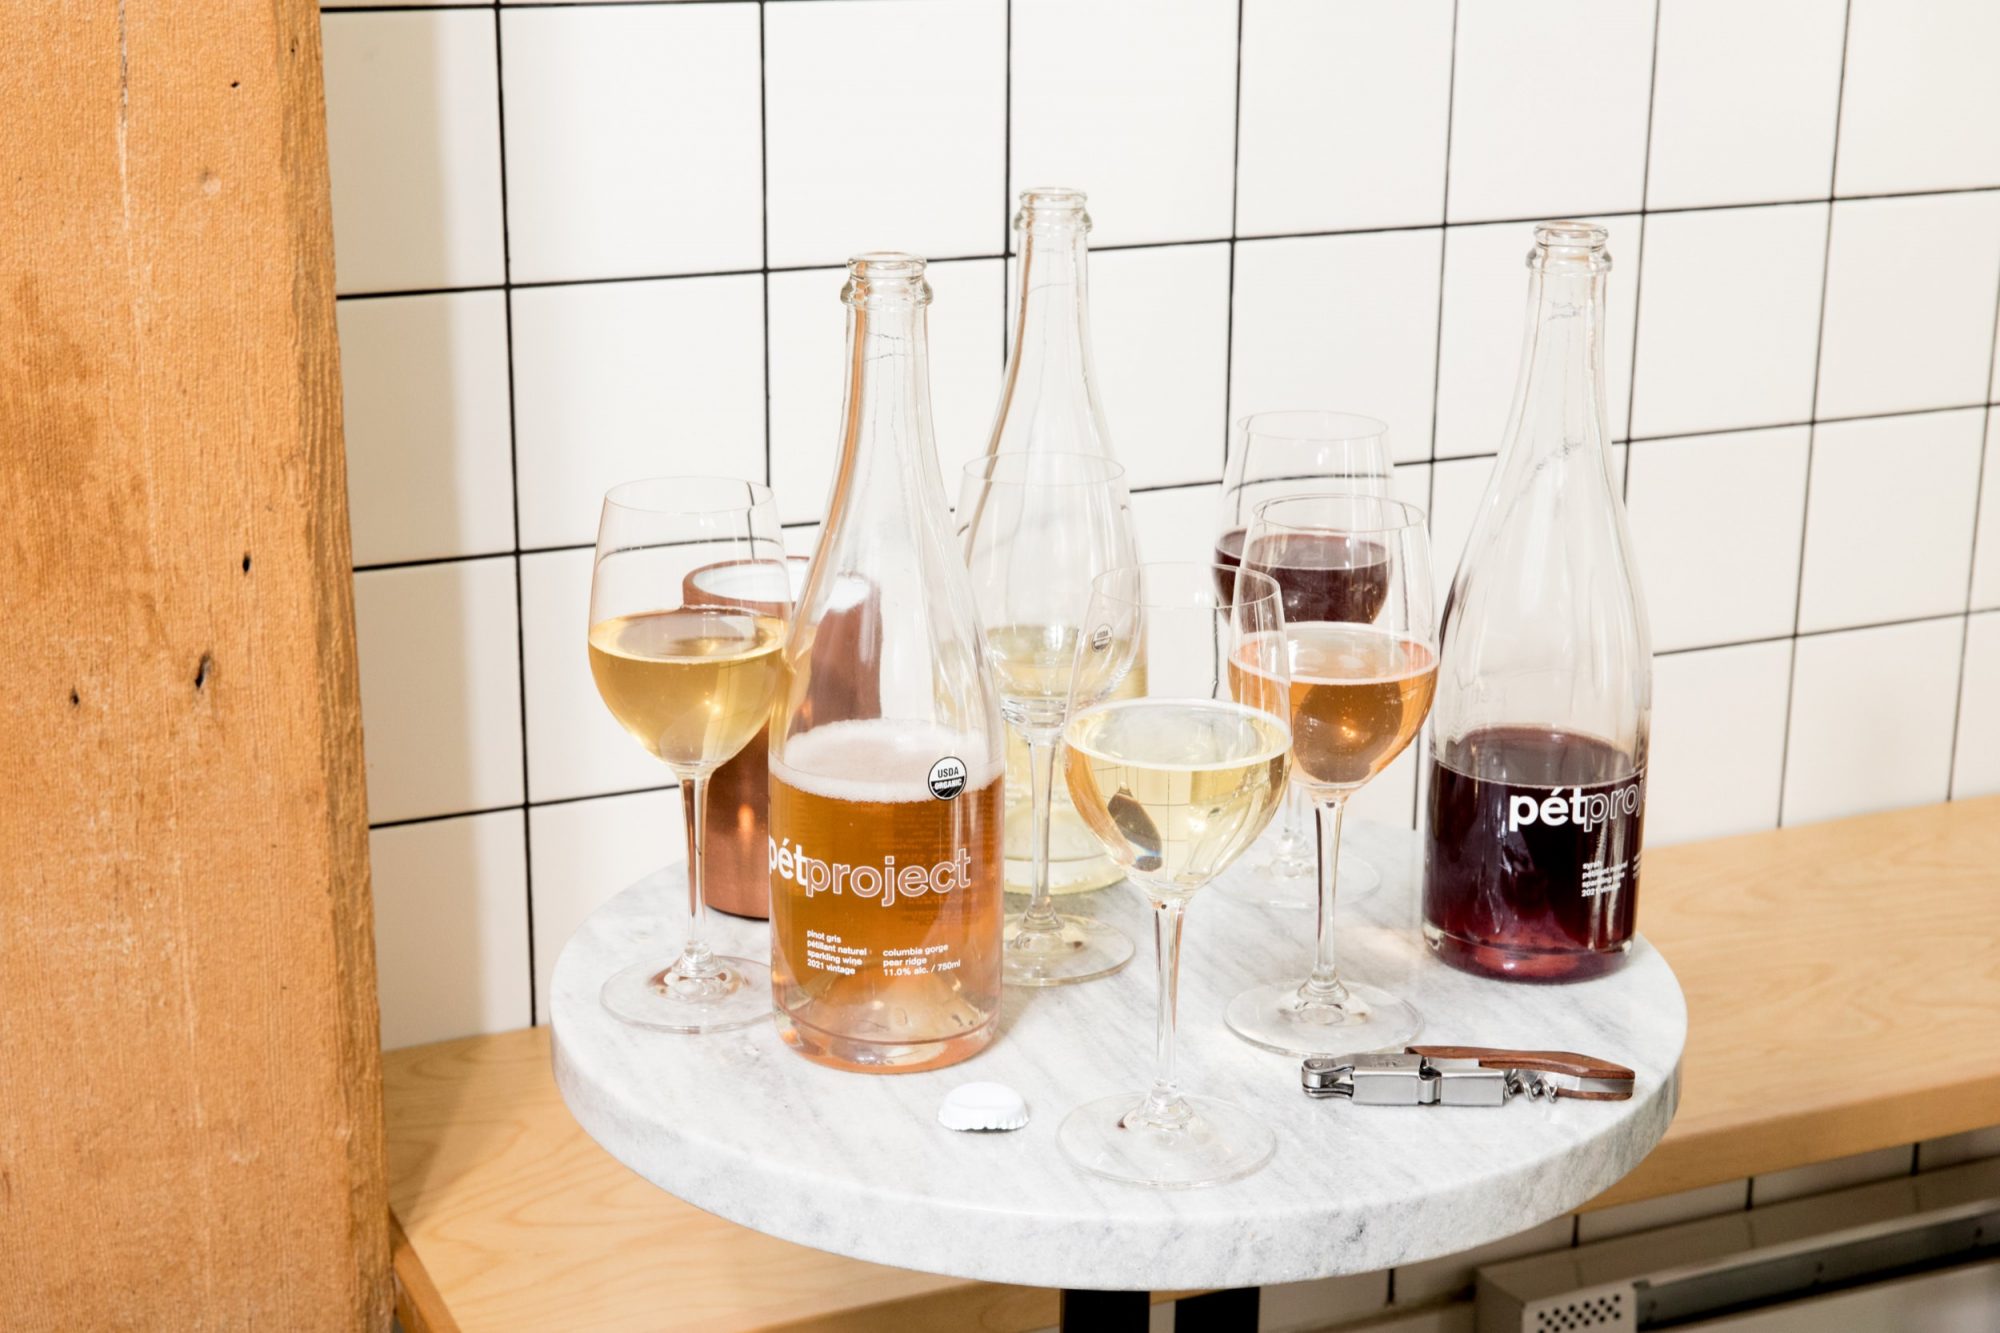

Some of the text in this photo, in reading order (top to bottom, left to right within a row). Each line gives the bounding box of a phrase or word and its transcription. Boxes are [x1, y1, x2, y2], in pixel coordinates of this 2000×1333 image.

[937, 766, 959, 778] USDA
[807, 930, 842, 944] pinot gris
[883, 944, 949, 957] columbia gorge
[807, 950, 863, 966] sparkling wine
[883, 957, 927, 968] pear ridge
[807, 959, 856, 976] 2021 vintage
[884, 968, 912, 976] 11.0%
[914, 966, 929, 975] alc.
[937, 959, 961, 972] 750ml
